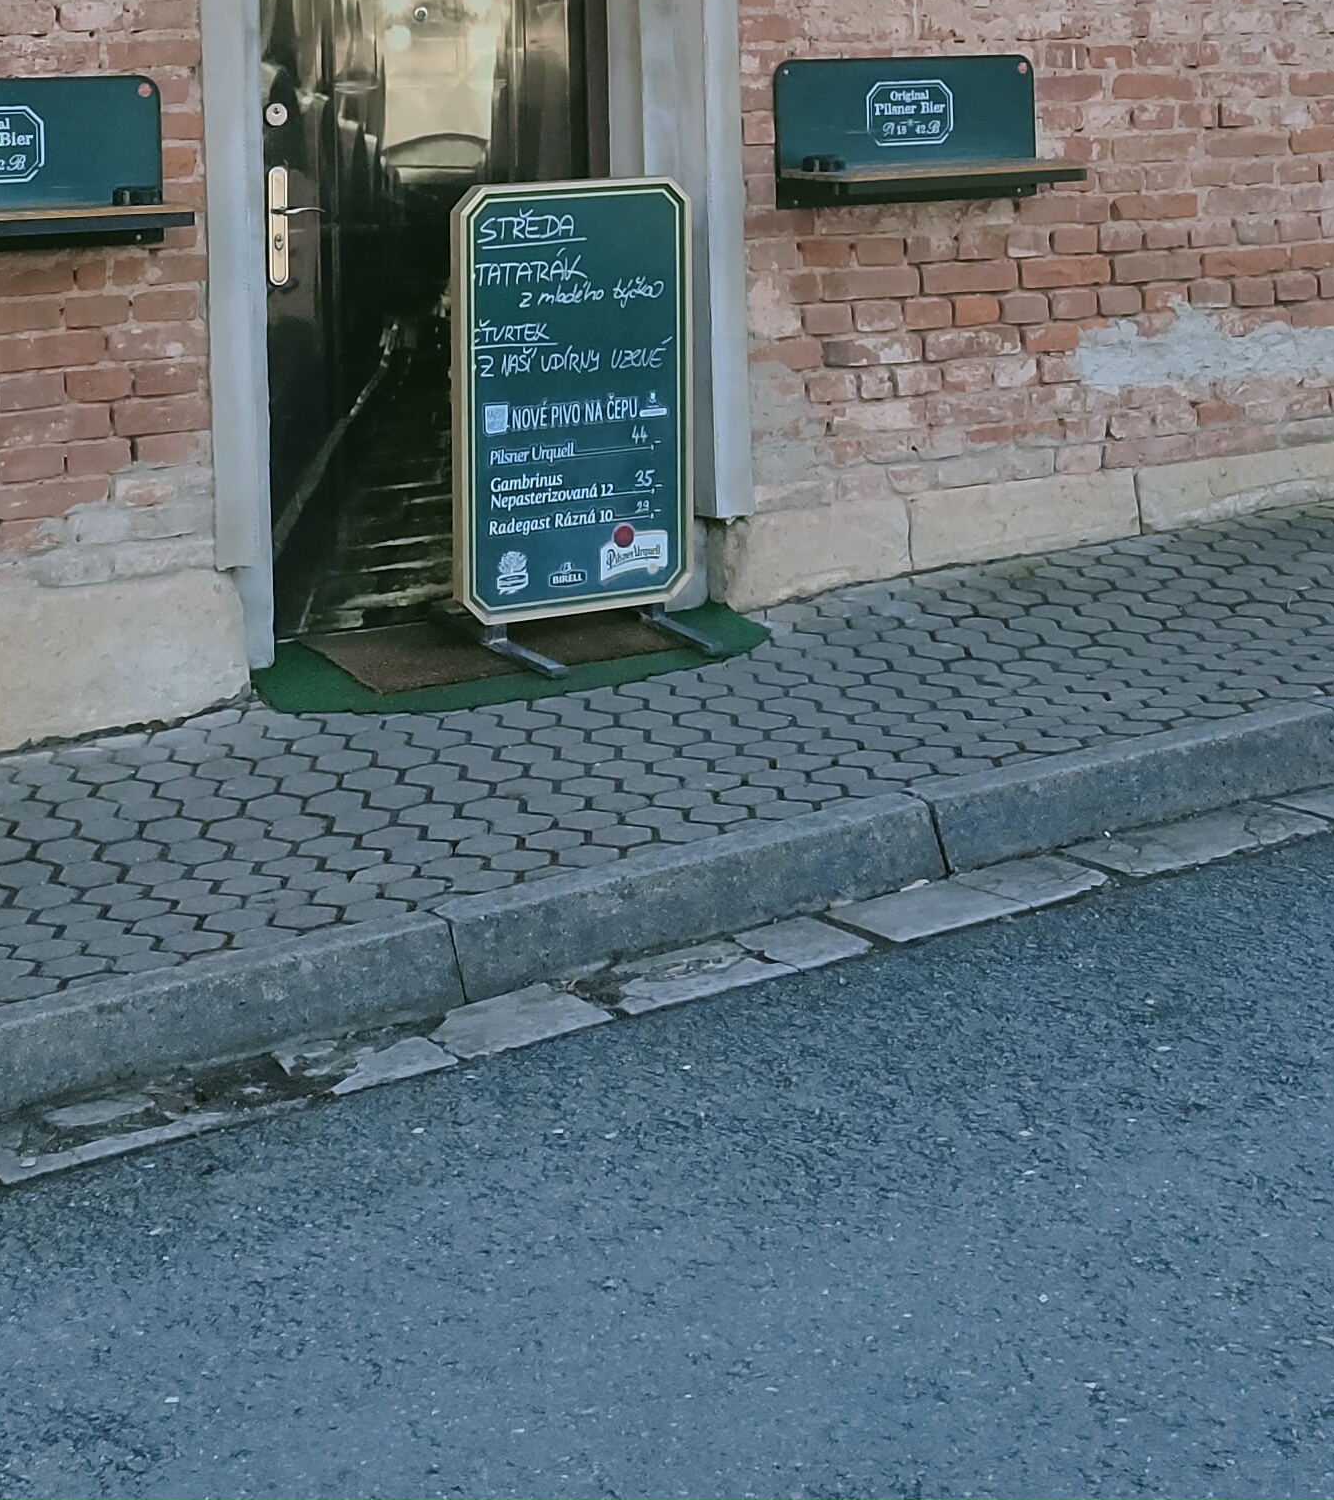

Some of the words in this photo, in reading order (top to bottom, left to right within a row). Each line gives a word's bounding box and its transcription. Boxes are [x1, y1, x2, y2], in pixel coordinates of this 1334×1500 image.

[874, 103, 917, 115] Pilsner
[920, 102, 946, 114] Bier
[890, 89, 929, 103] Original
[477, 208, 575, 244] STŘEDA
[475, 247, 588, 287] TATARÁK
[537, 280, 605, 306] mladého
[501, 347, 538, 377] NAŠÍ
[512, 399, 547, 429] NOVÉ
[551, 404, 581, 426] PIVO
[585, 405, 603, 422] NA
[606, 393, 638, 419] ČEPU
[490, 449, 530, 466] Pilsner
[532, 442, 575, 464] Urquell
[490, 473, 563, 493] Gambrinus
[491, 483, 598, 511] Nepasterizovaná
[600, 484, 614, 498] 12
[489, 515, 550, 536] Radegast
[555, 509, 596, 527] Rázná
[599, 509, 613, 523] 10
[606, 547, 634, 572] Pilsner
[633, 544, 661, 560] Urquell
[552, 573, 583, 585] BIRELL
